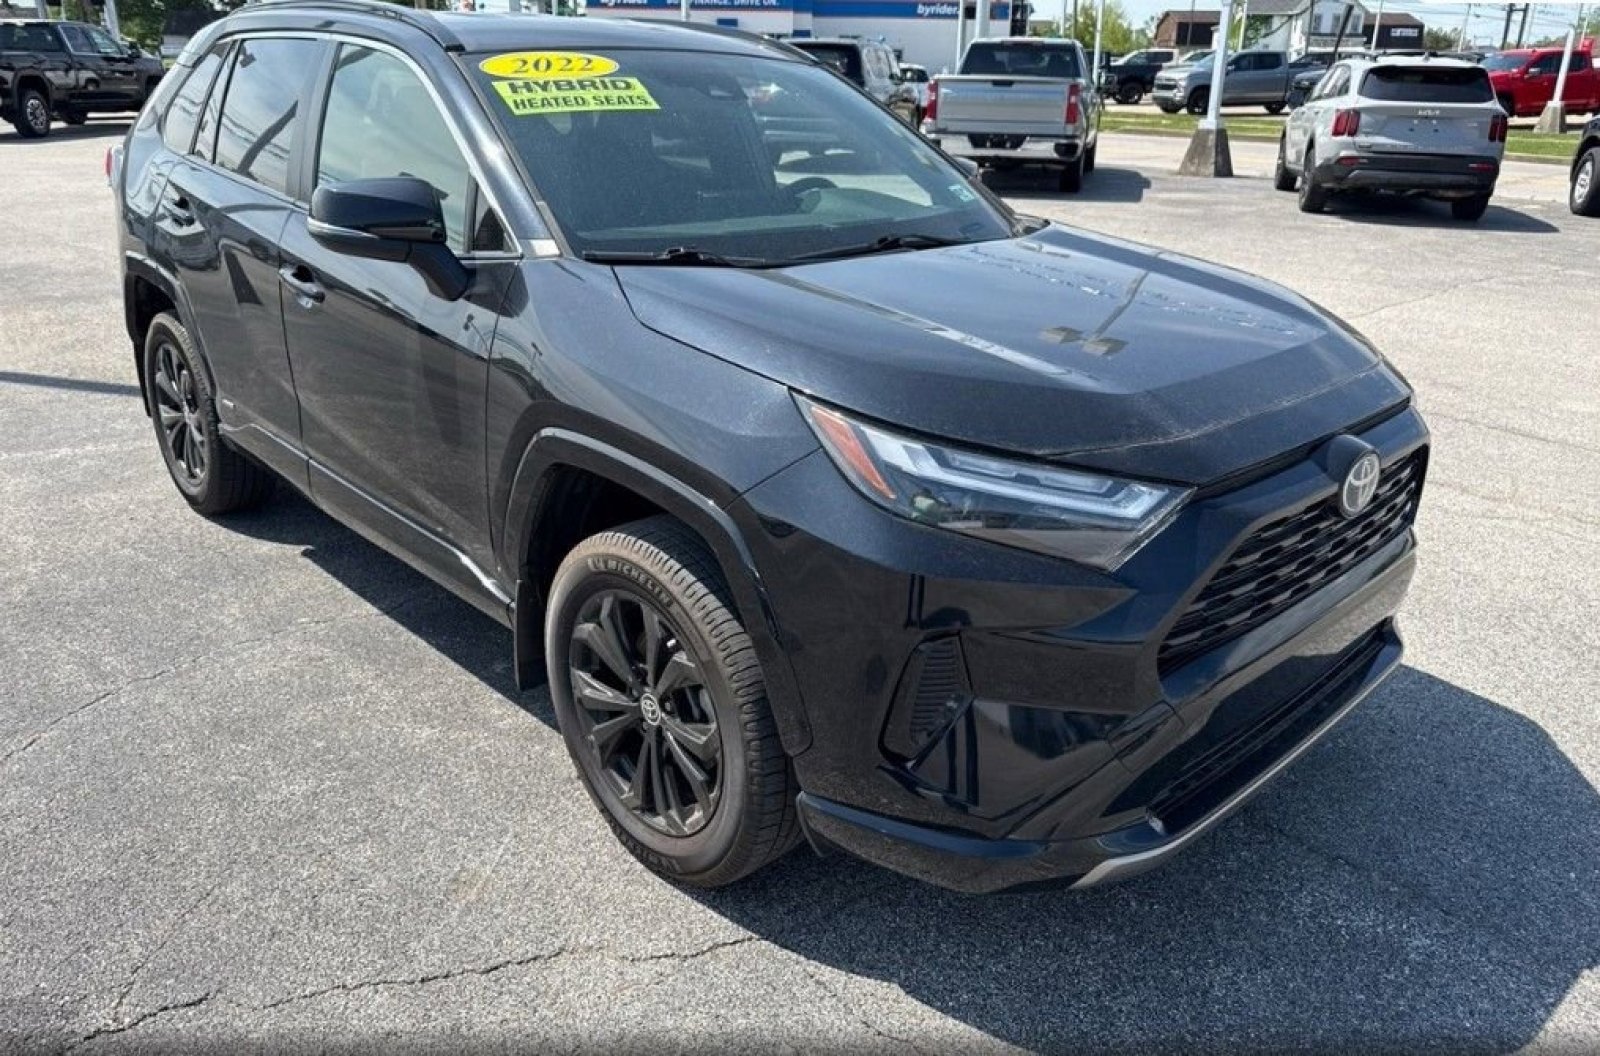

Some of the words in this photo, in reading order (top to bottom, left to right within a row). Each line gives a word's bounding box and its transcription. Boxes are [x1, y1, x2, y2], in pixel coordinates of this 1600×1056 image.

[512, 56, 594, 74] 2022
[508, 79, 633, 94] HYBRID
[513, 96, 585, 109] HEATED
[592, 93, 649, 106] SEATS
